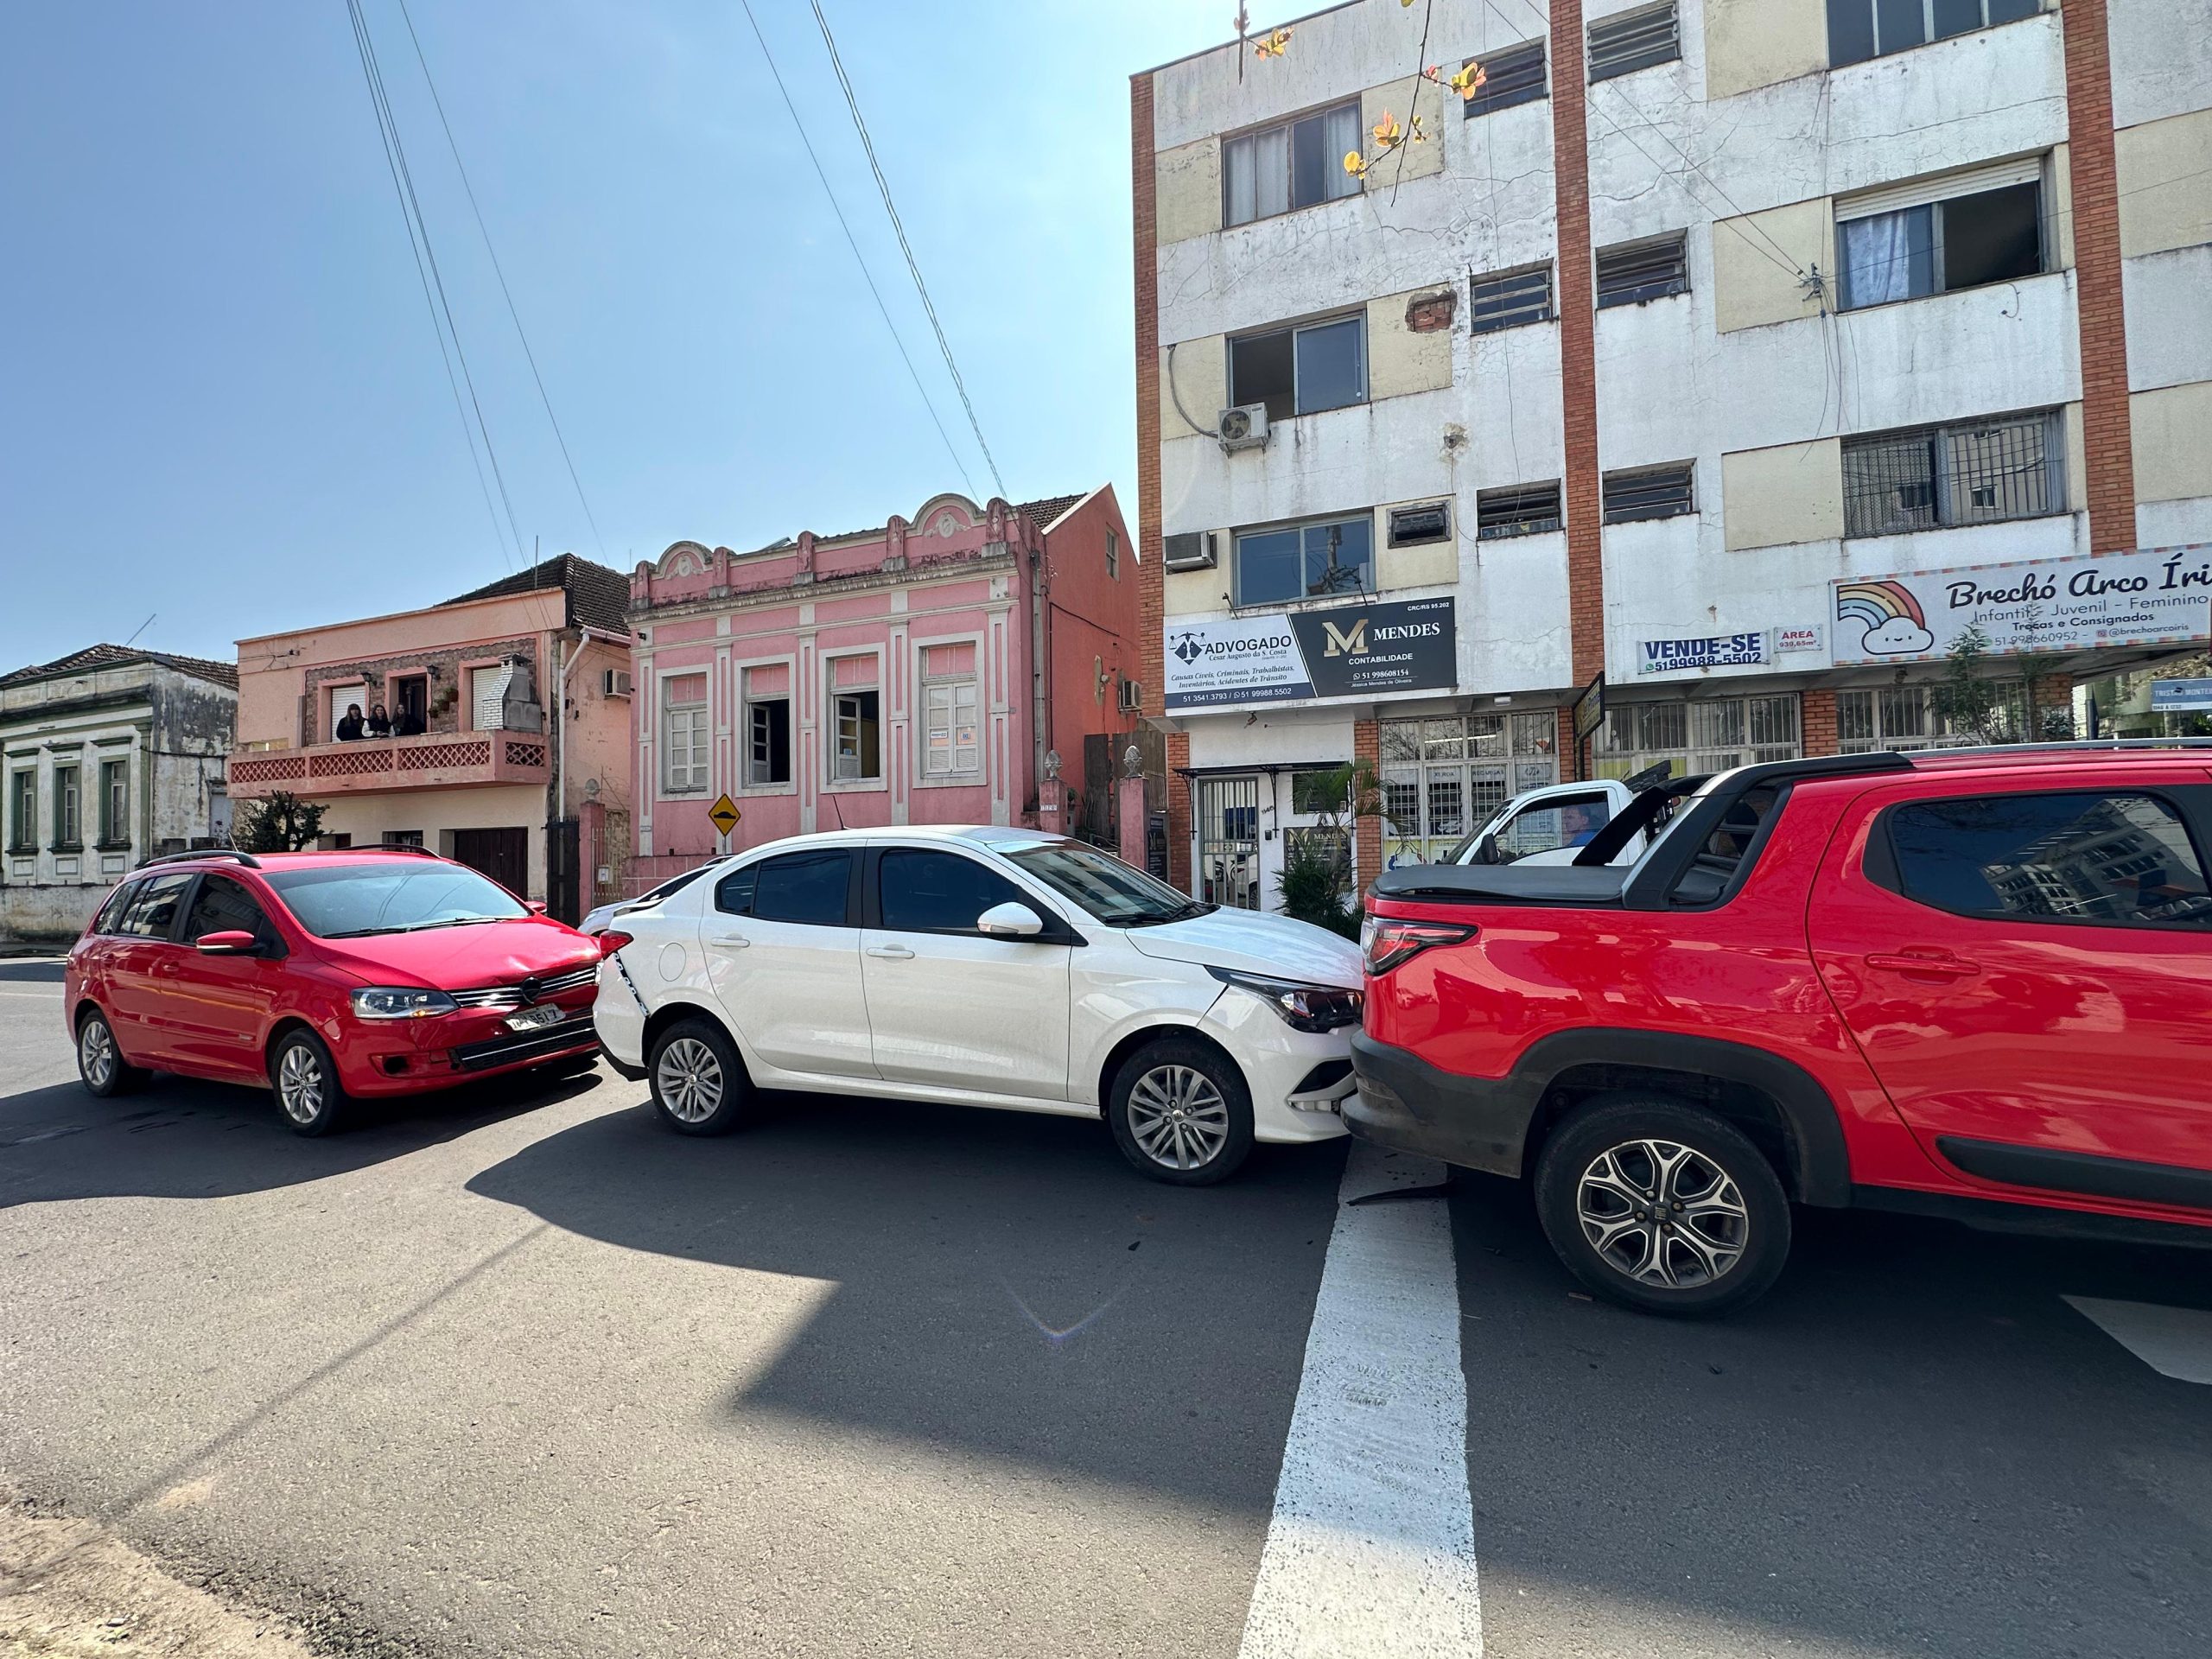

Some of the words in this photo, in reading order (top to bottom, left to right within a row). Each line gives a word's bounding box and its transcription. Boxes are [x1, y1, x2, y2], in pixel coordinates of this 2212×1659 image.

[1946, 573, 2056, 609] Brechó
[2069, 569, 2148, 597] Arco
[2050, 599, 2107, 616] Juvenil
[2130, 594, 2208, 610] Feminino
[2012, 621, 2054, 631] Trocas
[2073, 612, 2154, 626] Consignados
[1374, 622, 1440, 641] MENDES
[1782, 631, 1814, 639] AREA
[1205, 635, 1292, 655] ADVOGADO
[1645, 632, 1760, 659] VENDE-SE
[1227, 652, 1251, 661] Augusto
[1349, 653, 1413, 665] CONTABILIDADE
[1217, 677, 1249, 686] Acidentes
